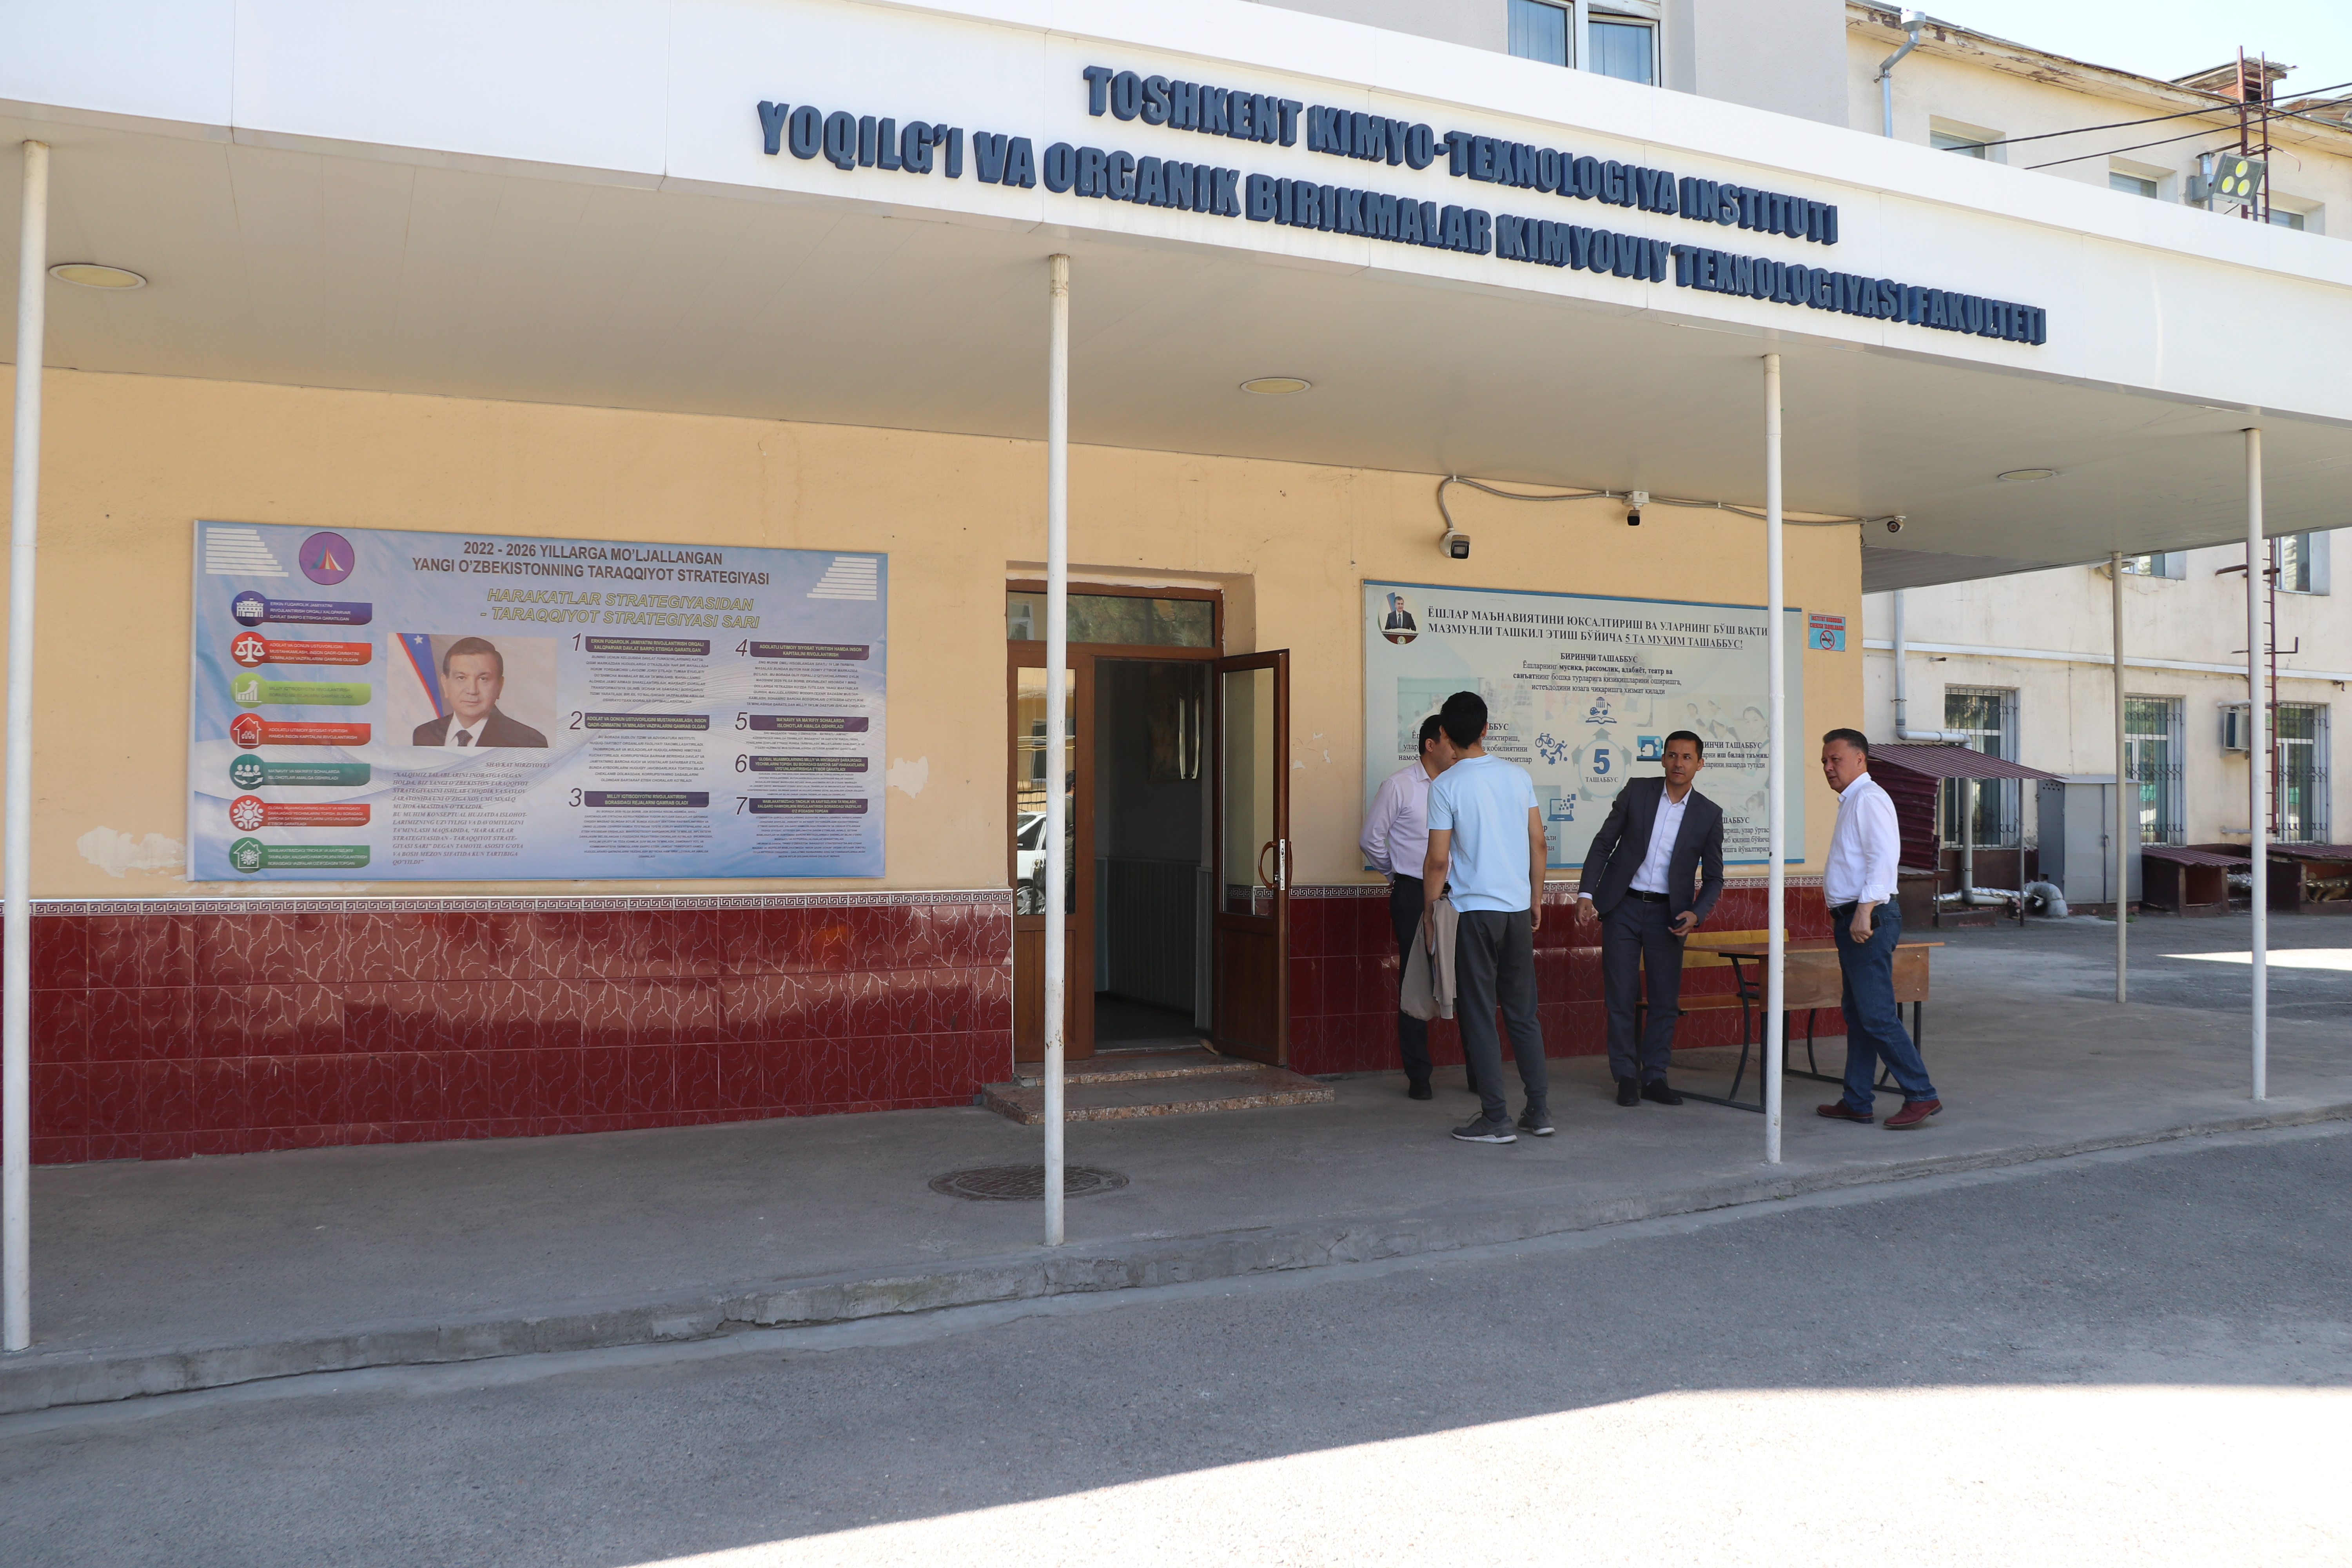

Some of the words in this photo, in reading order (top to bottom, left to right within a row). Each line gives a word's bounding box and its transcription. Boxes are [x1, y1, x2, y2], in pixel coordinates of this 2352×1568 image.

[1083, 65, 1303, 147] TOSHKENT
[1307, 105, 1679, 215] KIMYO-TEXNOLOGIYA
[1680, 177, 1839, 245] INSTITUTI
[973, 131, 1037, 189] VA
[1044, 142, 1241, 217] ORGANIK
[1245, 173, 1492, 255] BIRIKMALAR
[1496, 214, 1671, 283] KIMYOVIY
[1671, 244, 1909, 322] TEXNOLOGIYASI
[1909, 287, 2046, 346] FAKULTETI
[463, 541, 493, 555] 2022
[506, 543, 536, 557] 2026
[540, 544, 608, 560] YILLARGA
[412, 557, 454, 572] YANGI
[587, 564, 674, 583] TARAQQIYOT
[677, 568, 769, 585] STRATEGIYASI
[487, 588, 601, 606] HARAKATLAR
[604, 593, 753, 611] STRATEGIYASIDAN
[492, 607, 599, 625] TARAQQIYOT
[603, 611, 717, 628] STRATEGIYASI
[721, 615, 759, 629] SARI
[1428, 606, 1469, 620] ЁШЛАР
[1471, 610, 1564, 625] МАЪНАВИЯТИНИ
[1566, 616, 1642, 629] ЮКСАЛТИРИШ
[1645, 620, 1657, 630] ВА
[1660, 621, 1711, 633] УЛАРНИНГ
[1713, 622, 1735, 634] БЎШ
[572, 632, 581, 651] 1
[1428, 623, 1492, 635] МАЗМУНЛИ
[1495, 626, 1543, 638] ТАШКИЛ
[1546, 629, 1577, 640] ЭТИШ
[1580, 629, 1622, 642] БЎЙИЧА
[1625, 633, 1630, 642] 5
[1632, 634, 1644, 643] ТА
[1647, 635, 1685, 646] МУҲИМ
[1688, 637, 1743, 648] ТАШАББУС!
[735, 638, 748, 657] 4
[1523, 660, 1557, 671] Ёшларнинг
[1559, 664, 1584, 672] мусиқа,
[1585, 665, 1620, 673] рассомлик,
[1560, 652, 1596, 661] БИРИНЧИ
[1598, 654, 1638, 663] ТАШАББУС
[1551, 673, 1571, 682] бошқа
[1603, 677, 1649, 685] қизиқишларини
[569, 711, 583, 730] 2
[735, 711, 748, 730] 5
[735, 754, 747, 773] 6
[1593, 749, 1610, 775] 5
[568, 788, 582, 807] 3
[736, 797, 748, 815] 7
